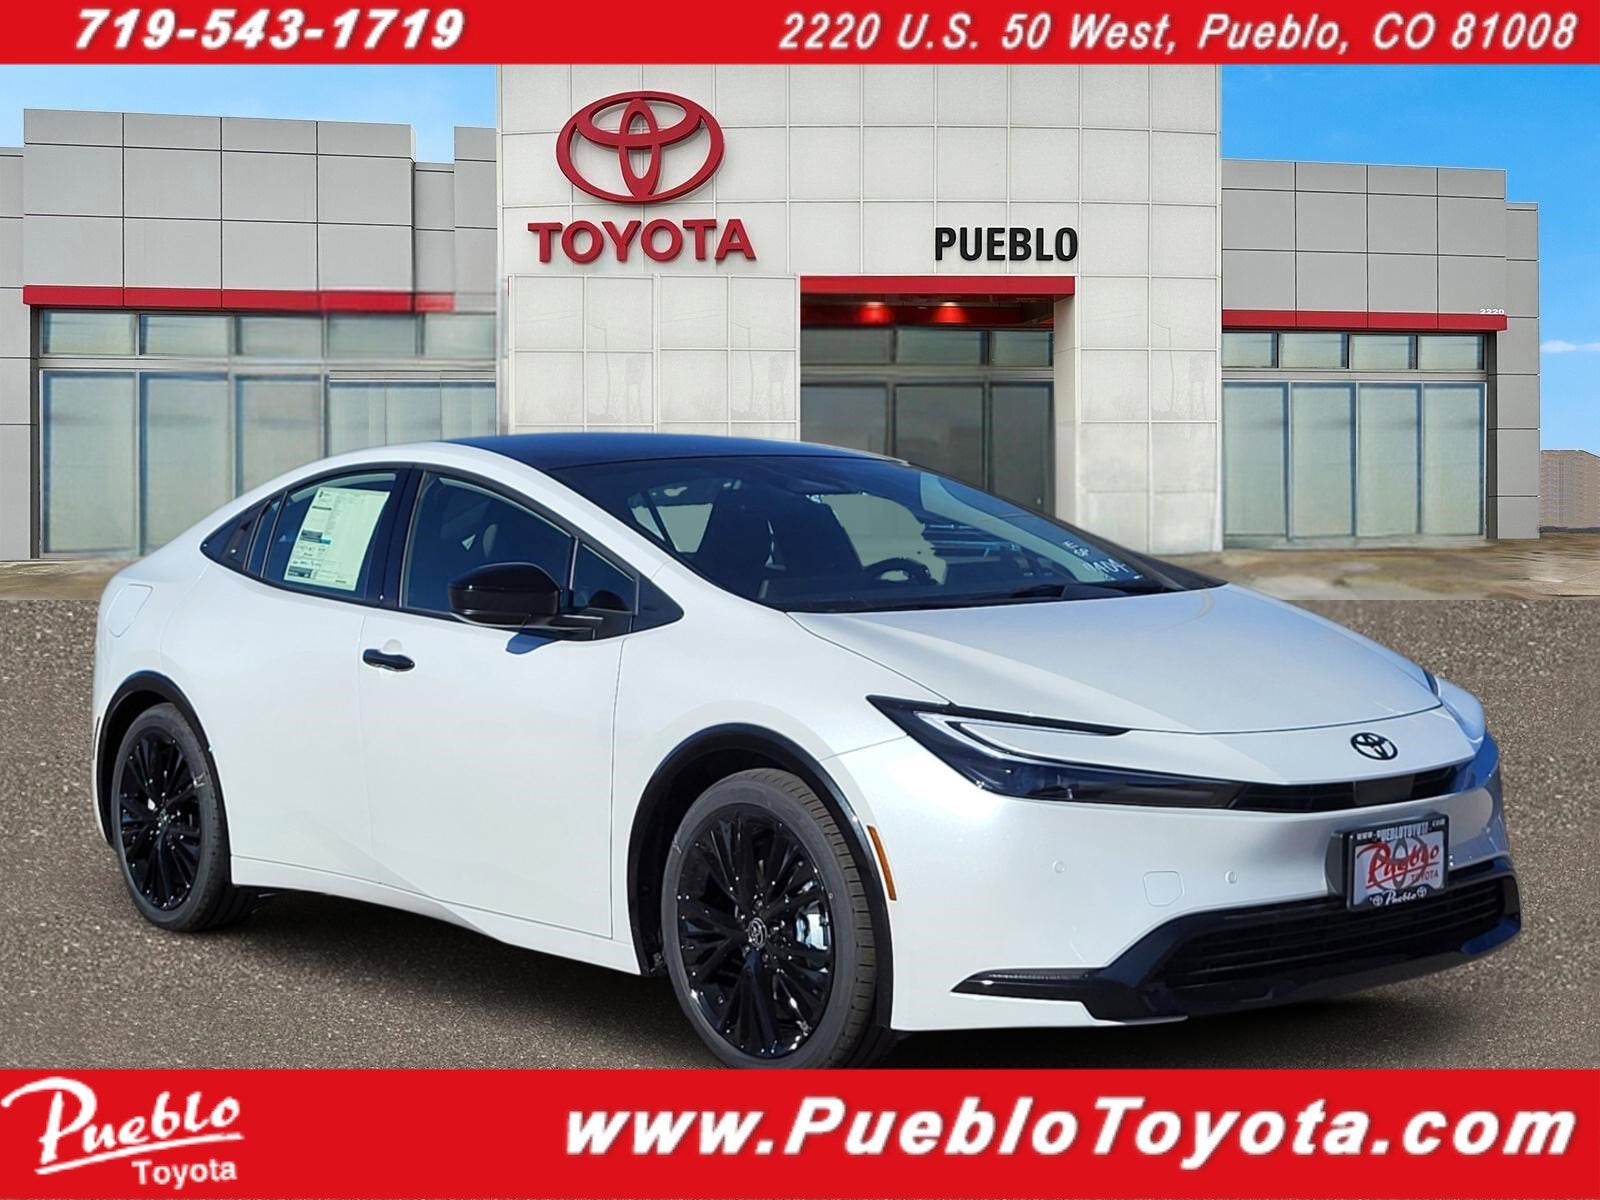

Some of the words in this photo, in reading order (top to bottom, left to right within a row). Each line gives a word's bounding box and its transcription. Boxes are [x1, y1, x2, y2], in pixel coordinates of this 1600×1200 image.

[528, 219, 755, 264] TOYOTA
[935, 227, 1079, 262] PUEBLO
[1357, 842, 1439, 884] Pueblo
[1410, 870, 1439, 882] TOYOTA
[1383, 889, 1417, 905] Pueblo
